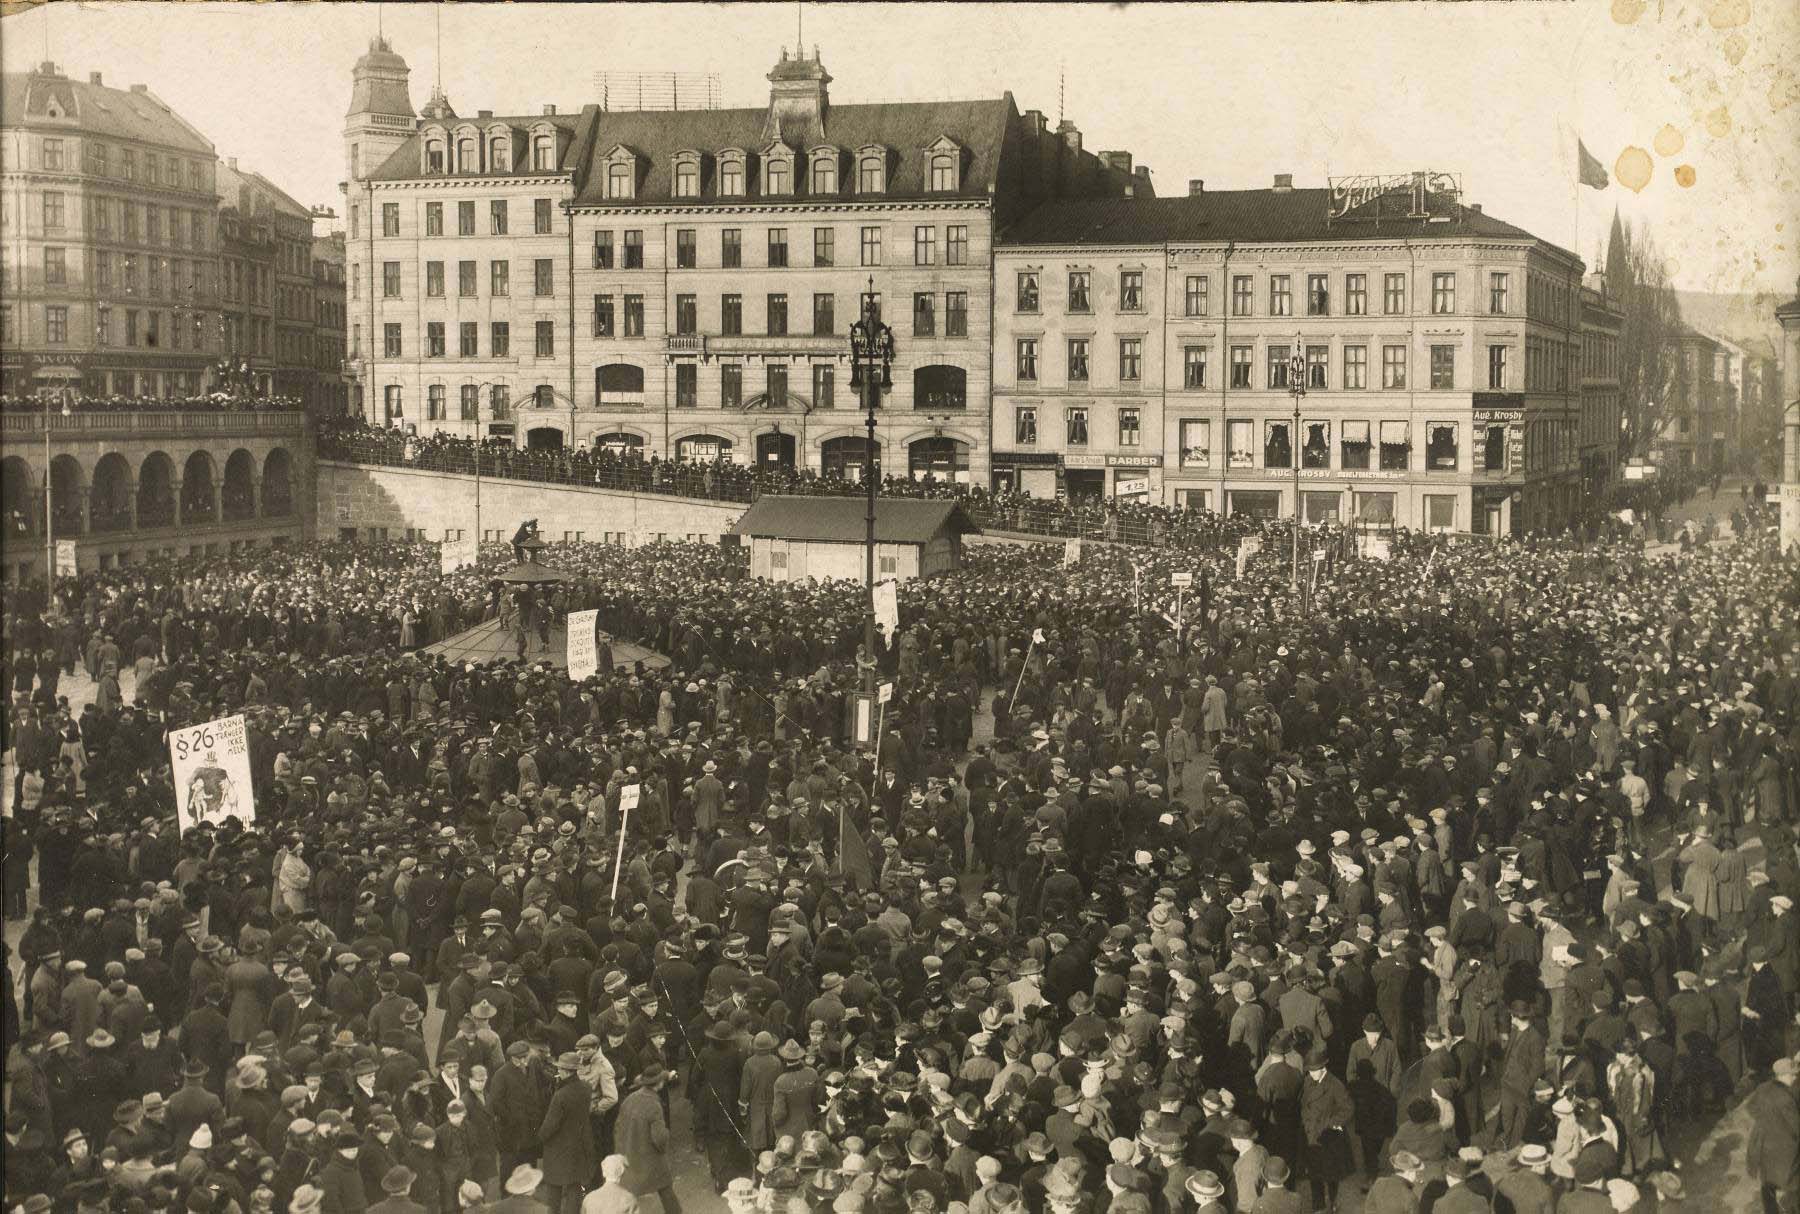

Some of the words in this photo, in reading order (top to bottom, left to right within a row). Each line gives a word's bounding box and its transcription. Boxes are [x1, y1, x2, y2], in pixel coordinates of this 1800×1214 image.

[1474, 411, 1492, 420] Aug.
[1494, 410, 1523, 420] Krosby
[1270, 470, 1292, 478] AUG.
[217, 719, 243, 731] BARNA
[192, 728, 215, 752] 26
[227, 736, 243, 747] IKKE
[227, 744, 246, 756] MELK
